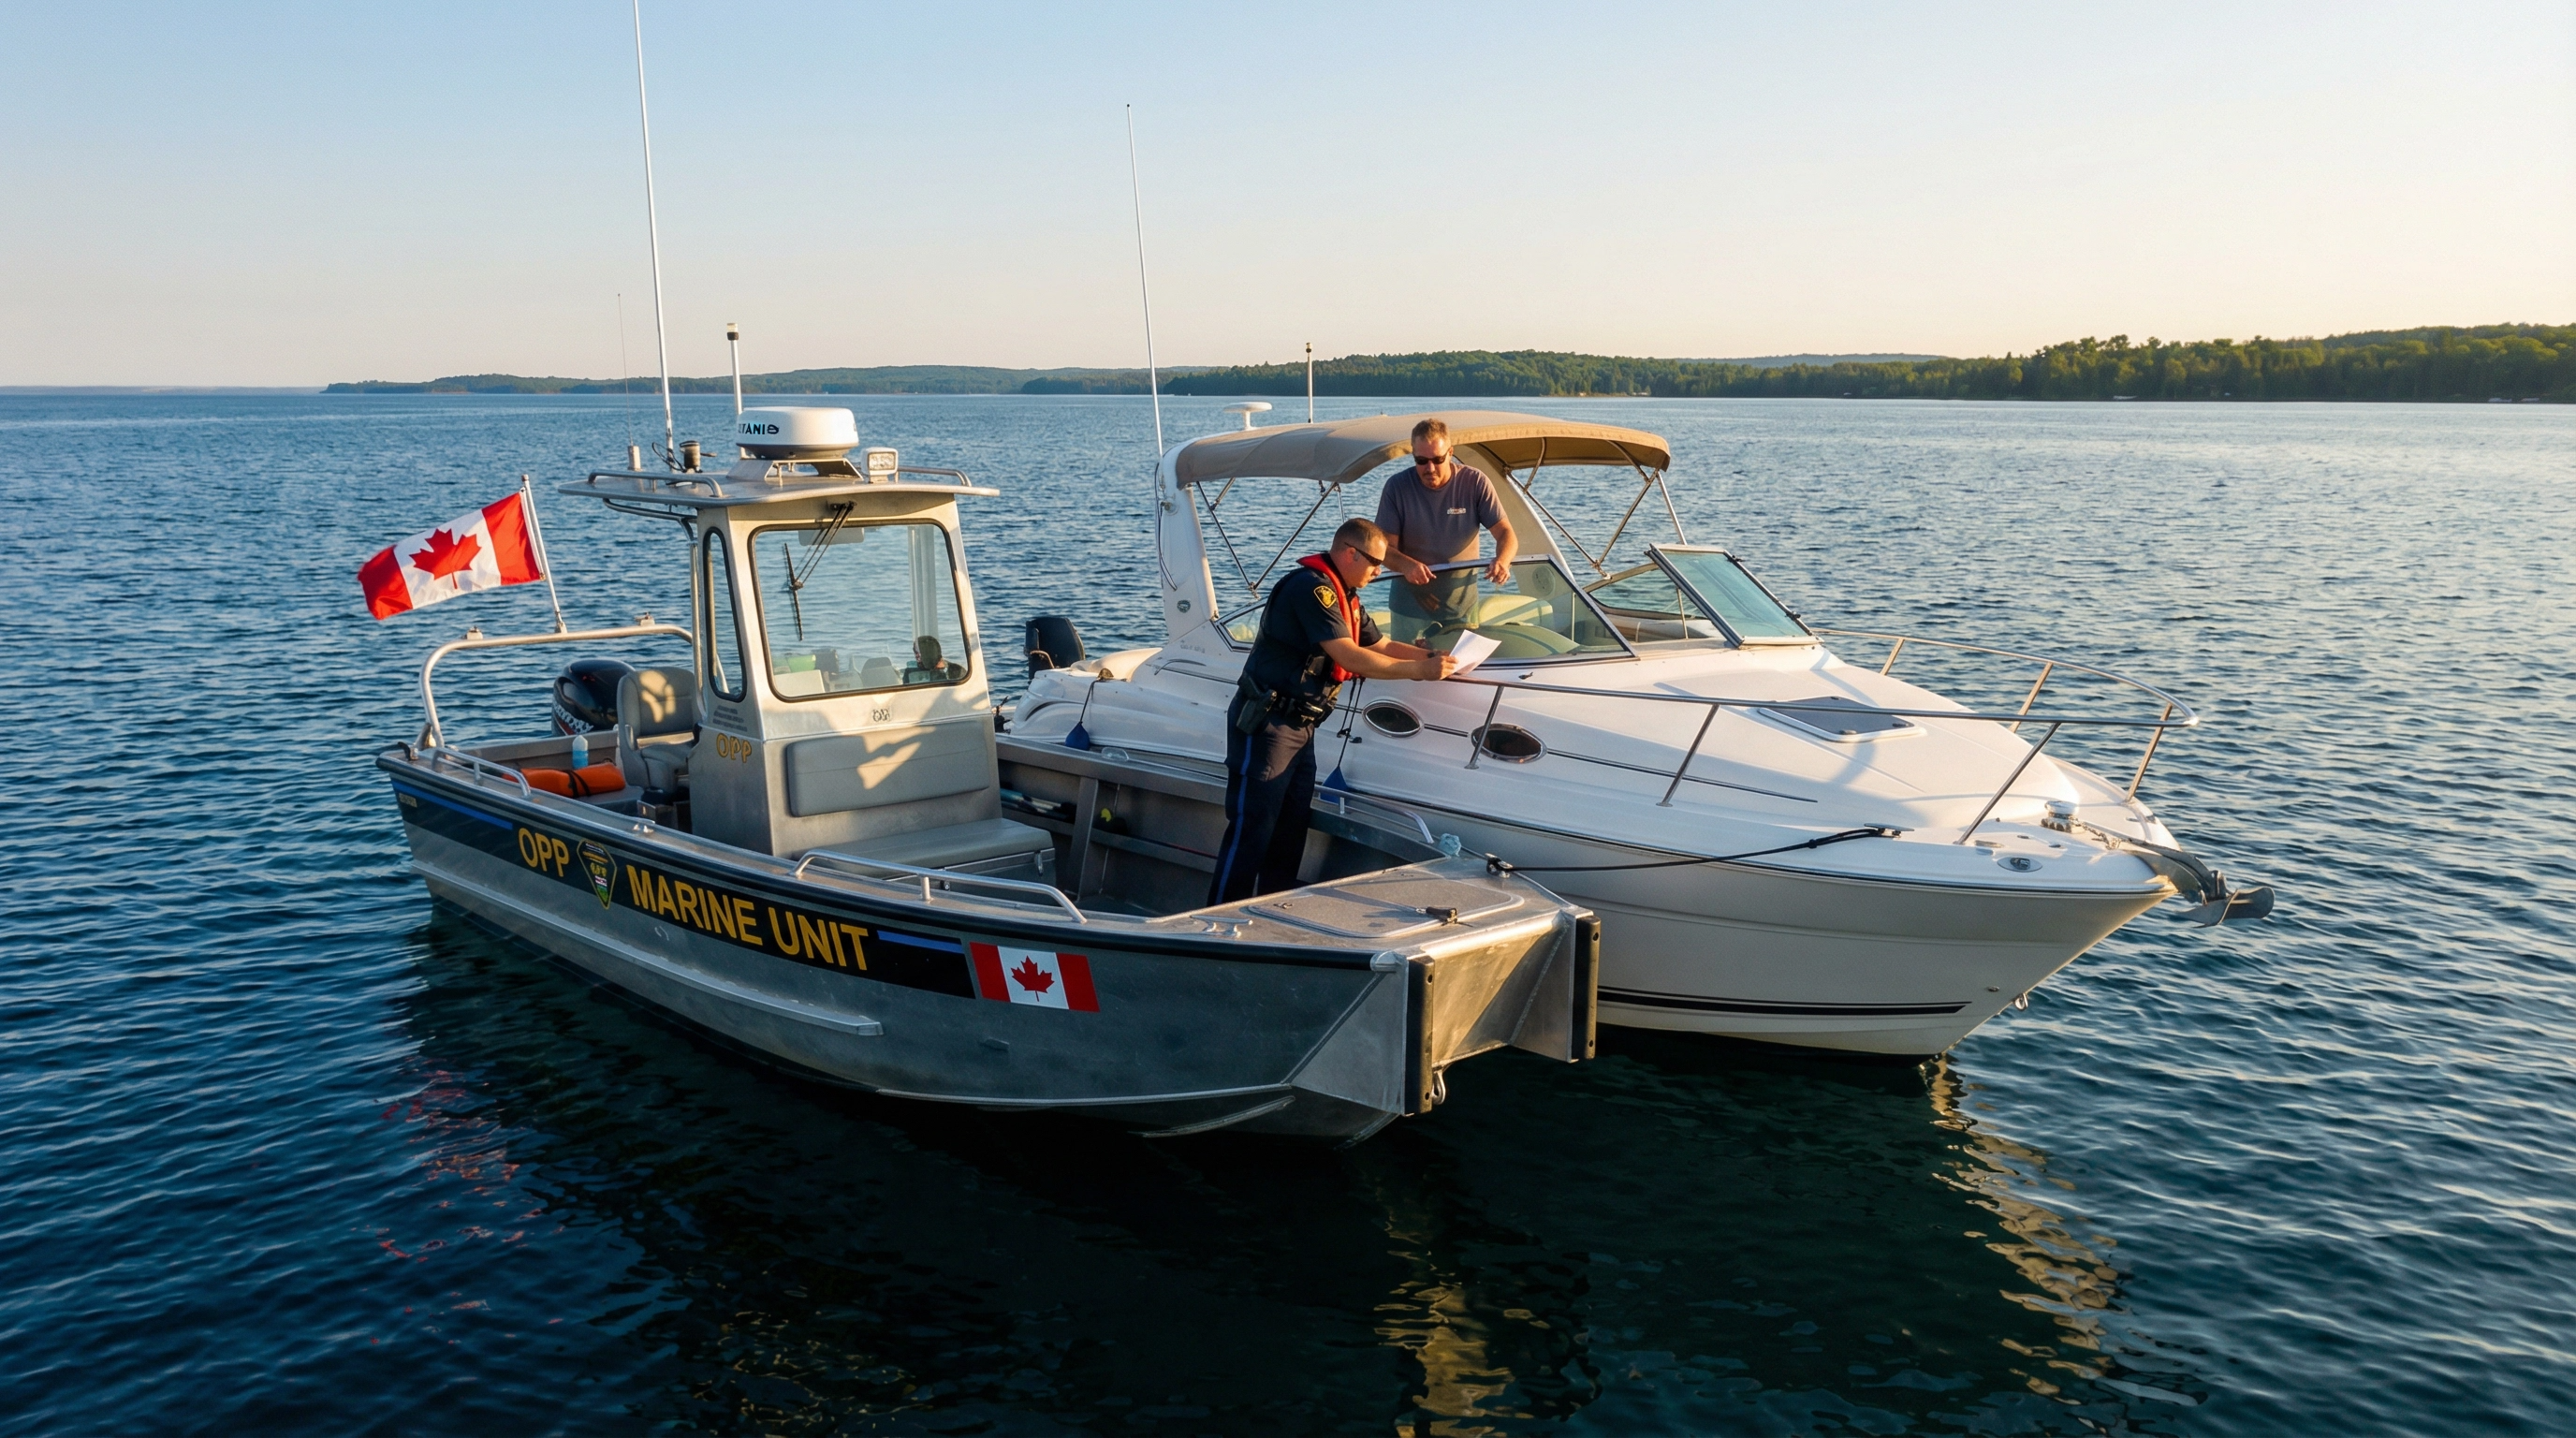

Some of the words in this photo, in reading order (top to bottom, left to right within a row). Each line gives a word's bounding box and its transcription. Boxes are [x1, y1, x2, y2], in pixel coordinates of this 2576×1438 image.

[716, 732, 753, 763] OPP
[519, 828, 570, 877] OPP
[626, 864, 763, 946] MARINE
[768, 907, 869, 971] UNIT
